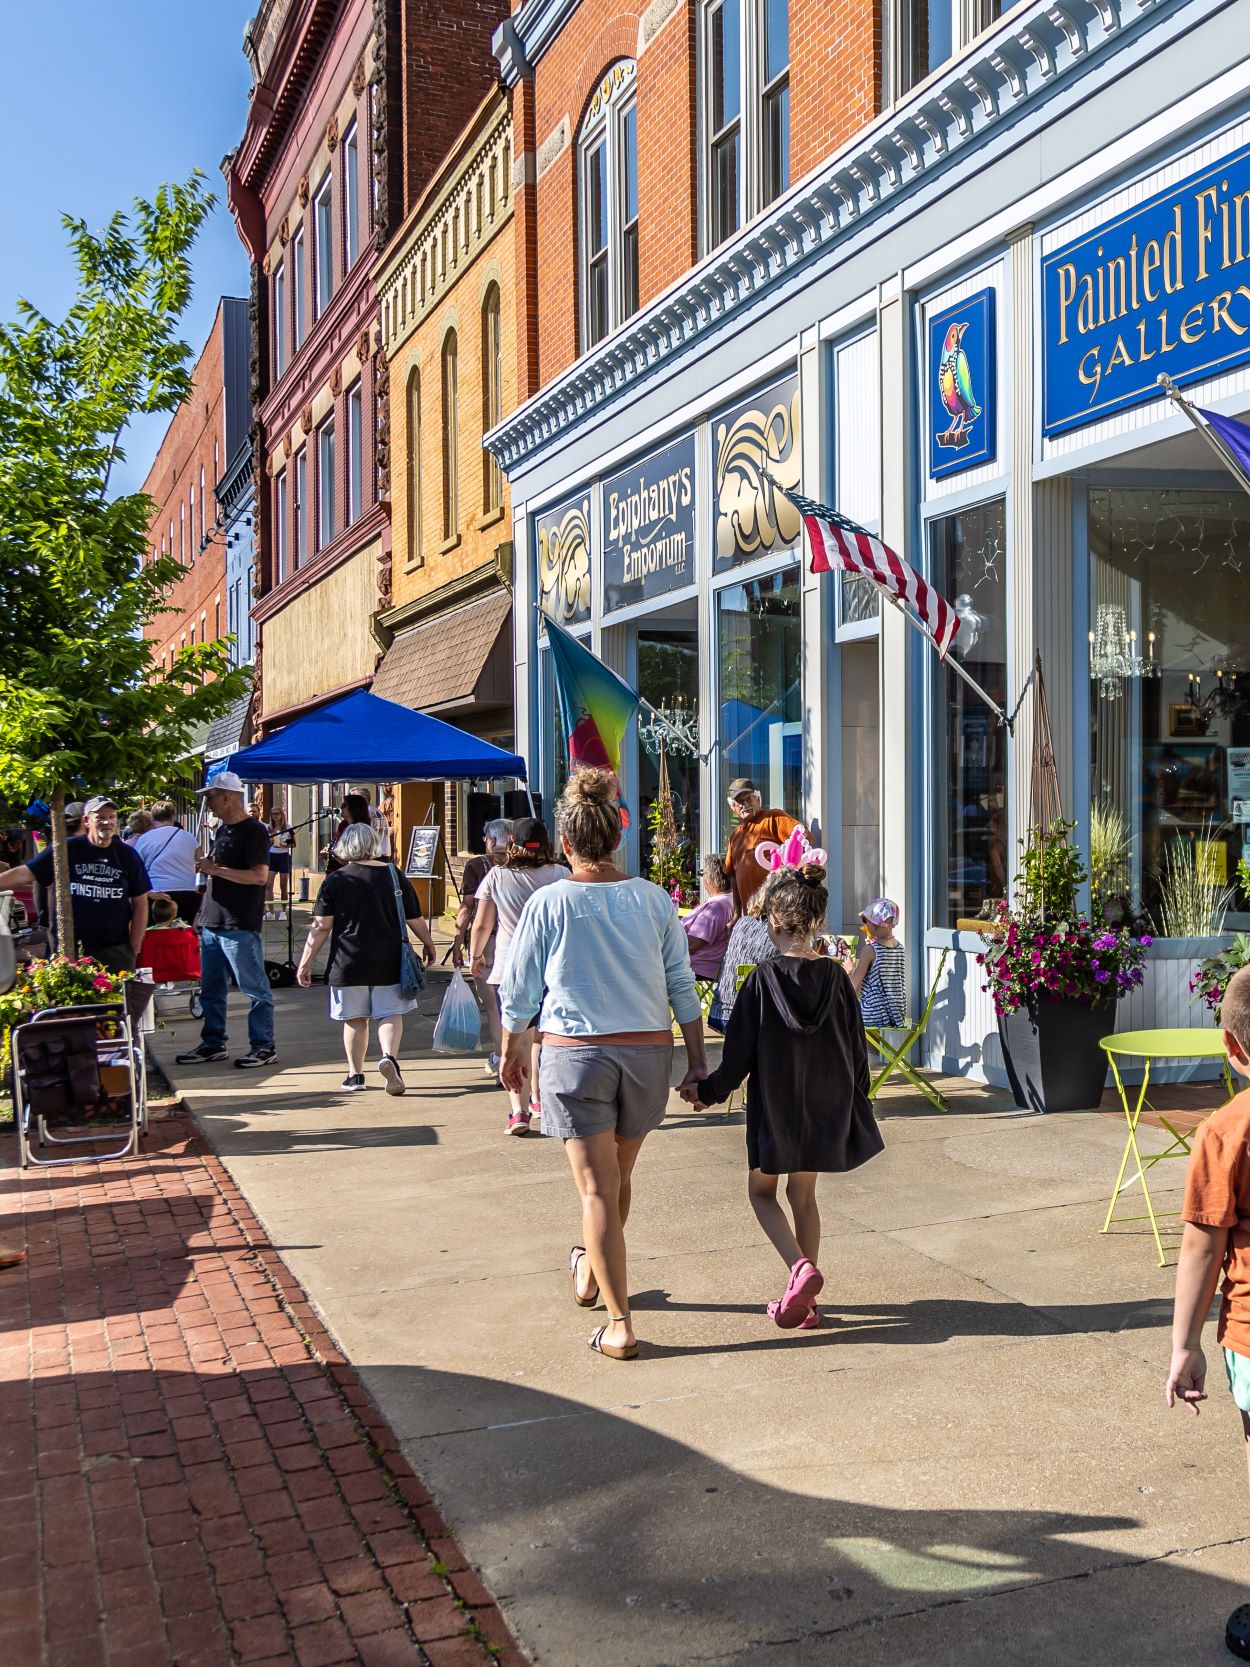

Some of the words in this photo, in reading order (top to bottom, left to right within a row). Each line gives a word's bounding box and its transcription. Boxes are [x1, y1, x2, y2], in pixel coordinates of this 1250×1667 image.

[1056, 203, 1186, 346] Painted
[608, 467, 692, 548] Epiphany's
[623, 530, 686, 585] Emporium
[70, 882, 124, 899] PINSTRIPES
[75, 863, 122, 880] GAMEDAYS
